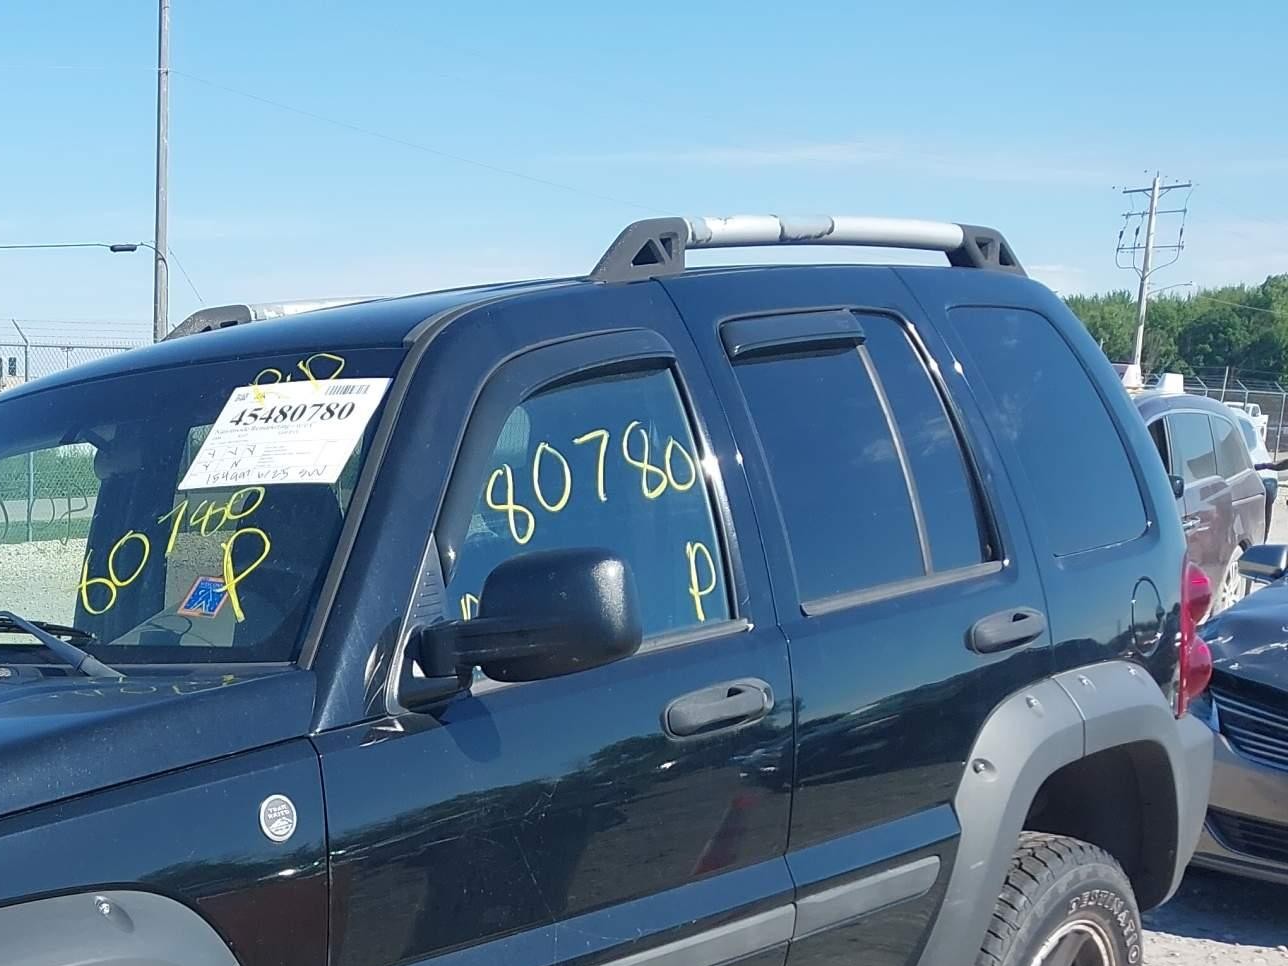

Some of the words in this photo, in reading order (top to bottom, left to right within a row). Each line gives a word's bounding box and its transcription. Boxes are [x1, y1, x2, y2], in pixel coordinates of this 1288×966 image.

[230, 401, 355, 426] 45480780
[486, 420, 697, 545] 80780
[685, 541, 716, 623] P
